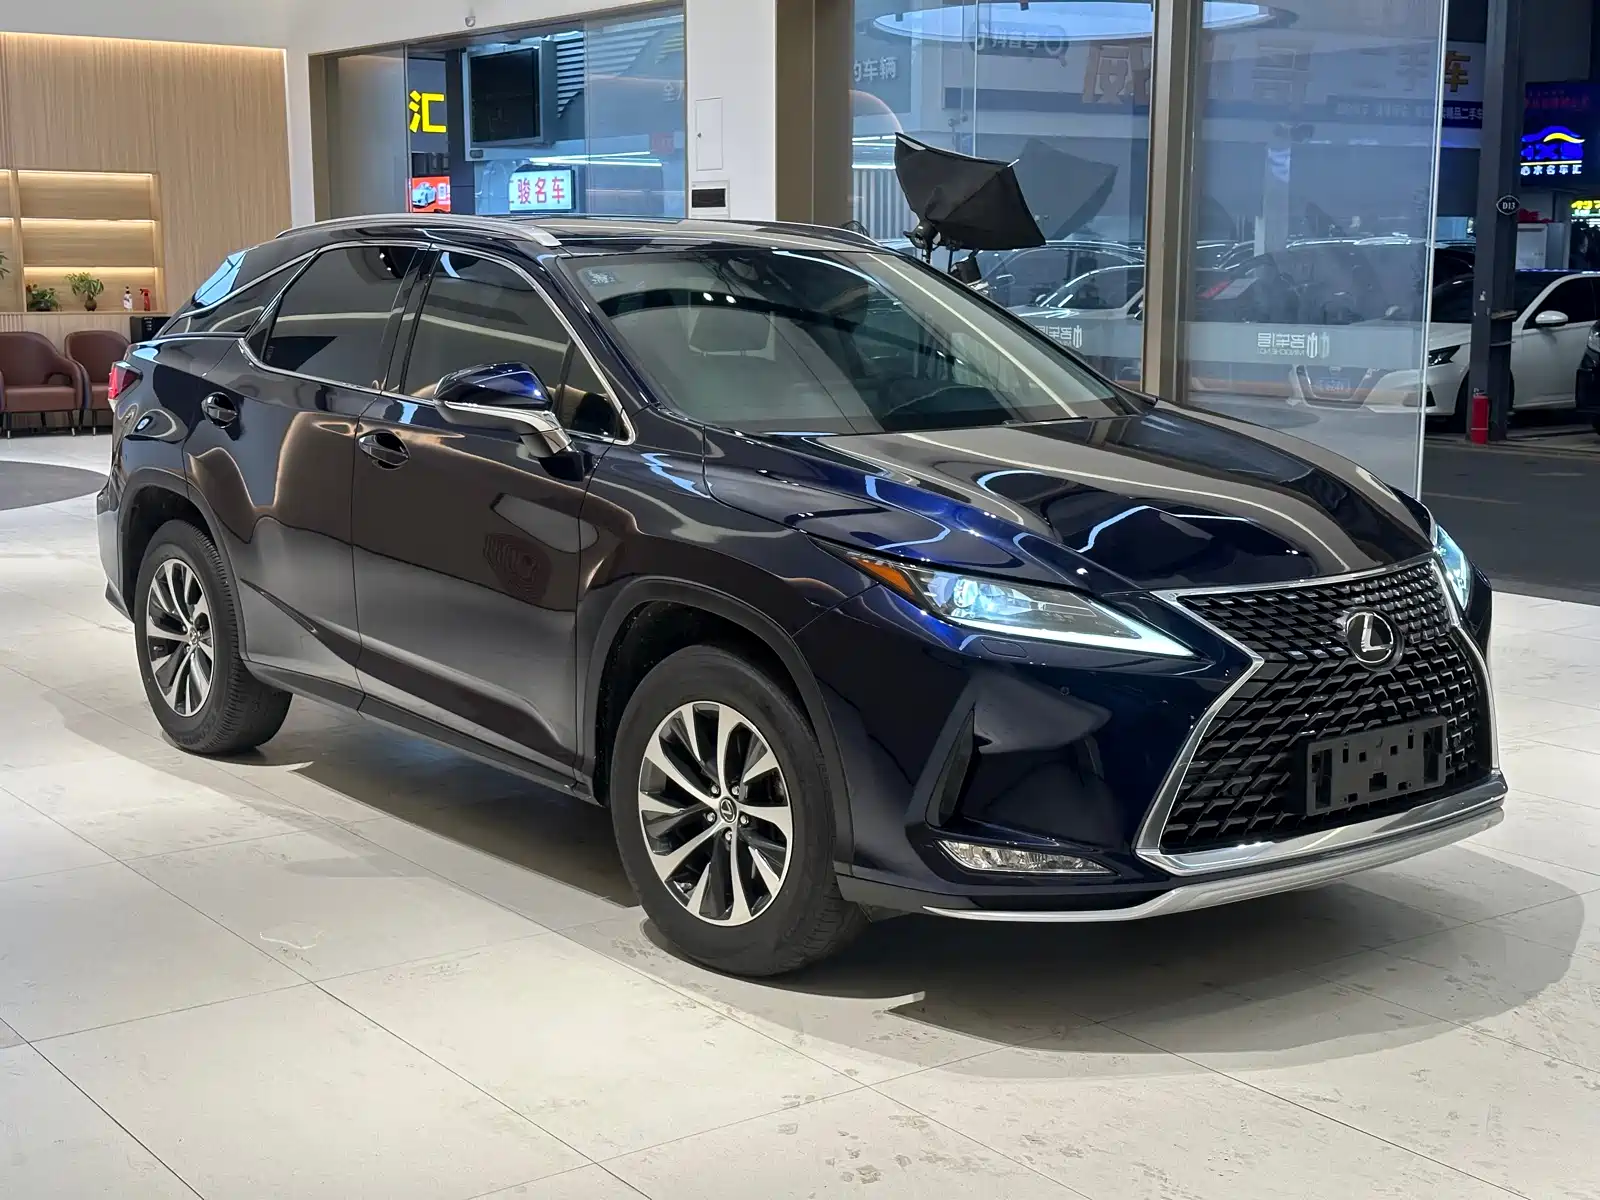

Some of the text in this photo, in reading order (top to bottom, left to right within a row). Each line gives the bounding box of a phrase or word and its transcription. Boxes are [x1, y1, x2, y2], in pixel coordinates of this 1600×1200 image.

[408, 90, 447, 133] 汇
[509, 176, 565, 204] 骏名车
[1502, 201, 1516, 210] D13
